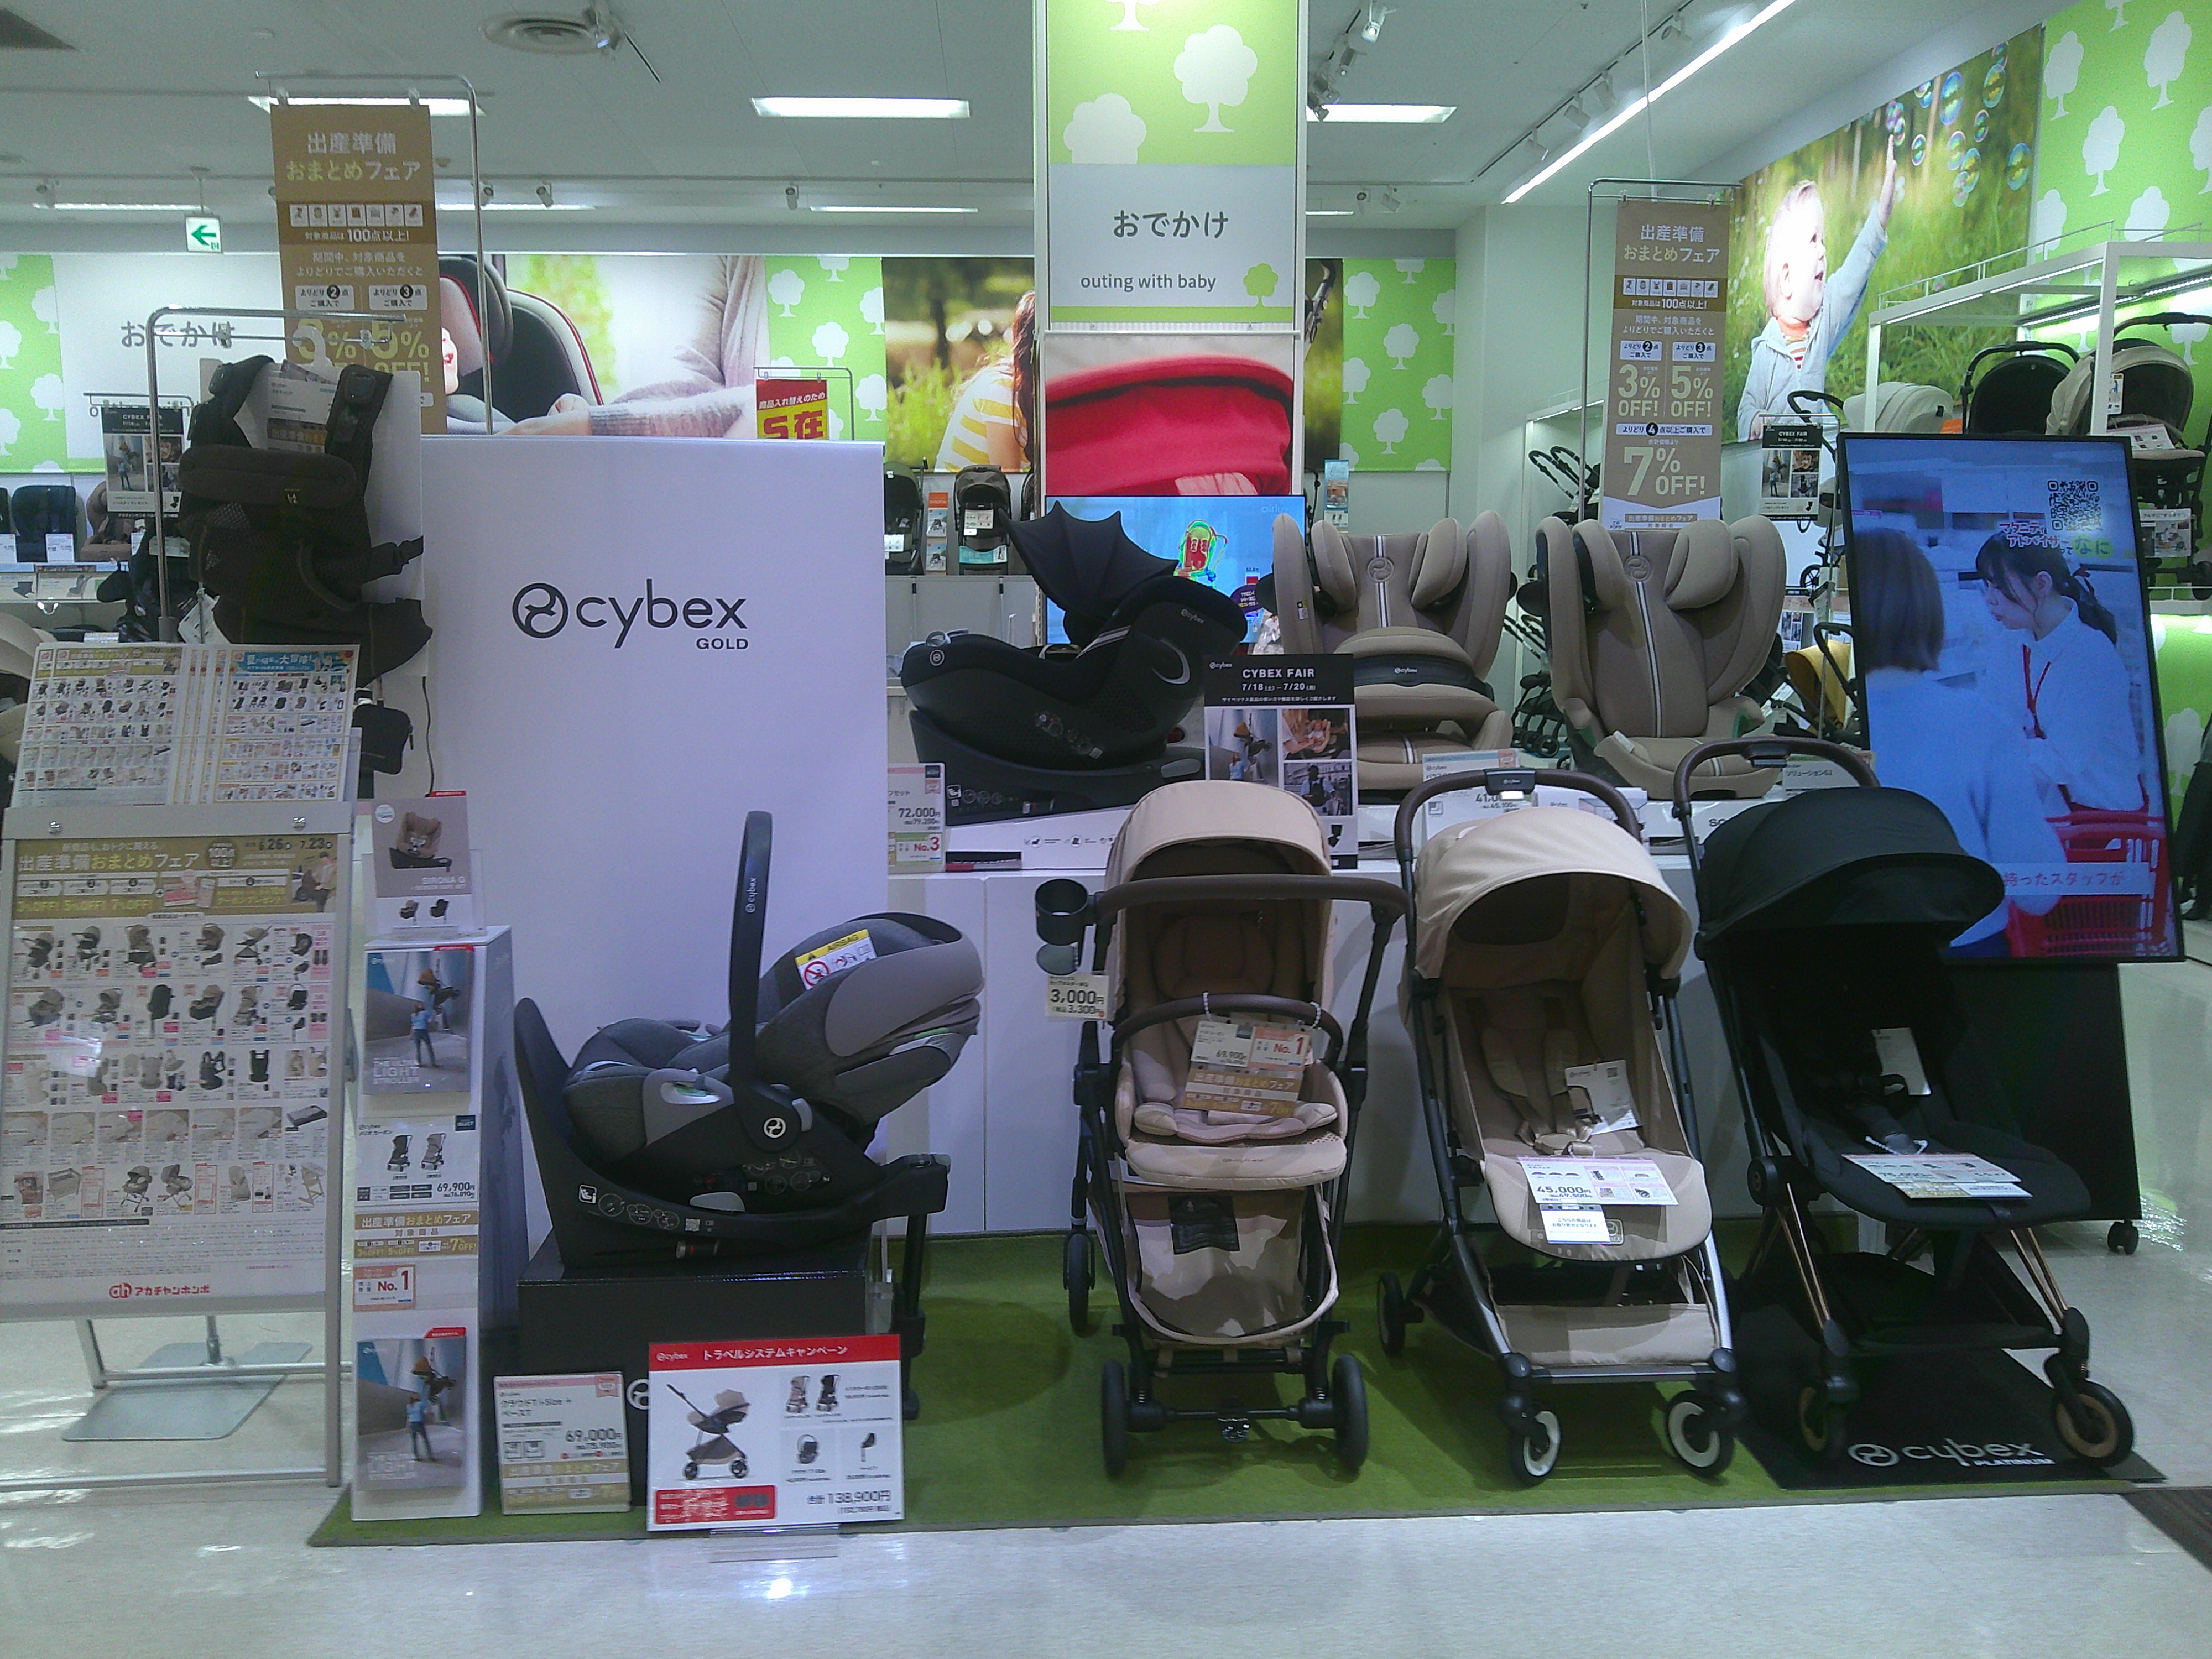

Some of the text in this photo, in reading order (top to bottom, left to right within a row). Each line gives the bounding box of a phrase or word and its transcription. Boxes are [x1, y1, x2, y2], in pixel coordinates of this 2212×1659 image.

[308, 132, 397, 155] 出産準備
[286, 160, 421, 182] おまとめフェア
[1113, 210, 1229, 238] おでかけ
[1641, 224, 1704, 242] 出産準備
[1624, 244, 1721, 263] おまとめフェア
[1081, 273, 1216, 293] outing with baby
[1618, 364, 1660, 398] 3%
[1671, 365, 1714, 399] 5%
[759, 392, 825, 410] 商品入れ替えのため
[1618, 400, 1658, 417] OFF!
[1671, 401, 1712, 418] OFF!
[1655, 475, 1705, 495] OFF!
[576, 578, 748, 649] cybex
[696, 638, 749, 650] GOLD
[1242, 668, 1315, 679] CYBEX FAIR
[898, 807, 941, 818] 72,000円
[747, 877, 758, 903] cybex
[827, 934, 859, 952] AIRBAG
[1050, 989, 1104, 1005] 3,000円
[373, 1066, 420, 1077] LIGHT
[437, 1182, 475, 1192] 69,900円
[1537, 1186, 1592, 1194] 45,000円
[361, 1213, 471, 1228] 出産準備おまとめフェア
[134, 1285, 210, 1296] アカチャンホンポ
[703, 1344, 848, 1361] トラベルシステムキャンペーン
[1901, 1438, 2045, 1467] cybex
